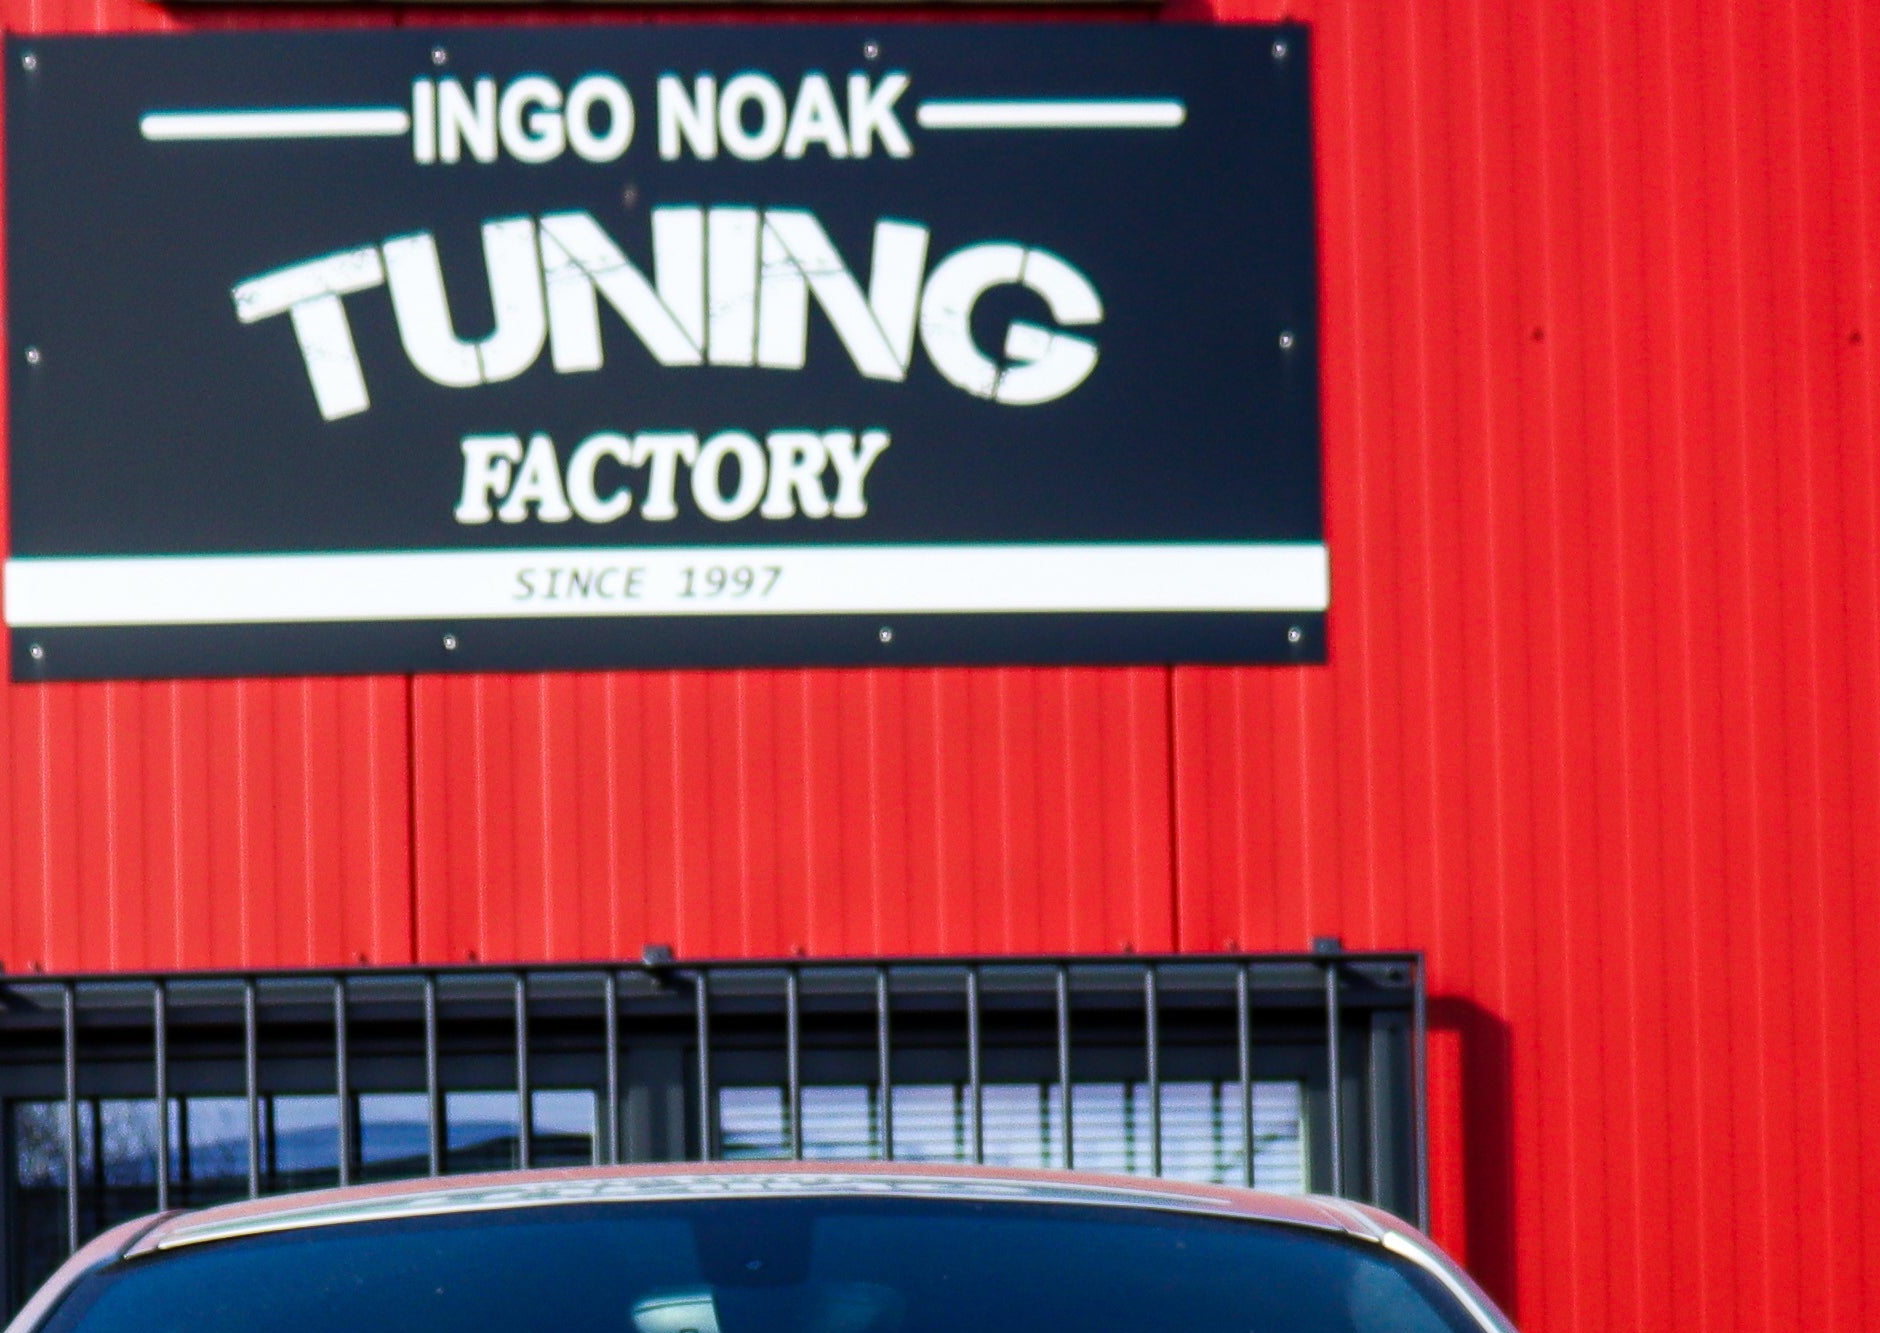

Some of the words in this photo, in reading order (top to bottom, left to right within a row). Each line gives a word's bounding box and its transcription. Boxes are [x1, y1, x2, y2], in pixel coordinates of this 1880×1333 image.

[412, 74, 635, 165] INGO
[657, 72, 913, 162] NOAK
[231, 205, 1104, 421] TUNING
[455, 430, 891, 525] FACTORY
[512, 566, 646, 600] SINCE
[676, 565, 783, 599] 1997
